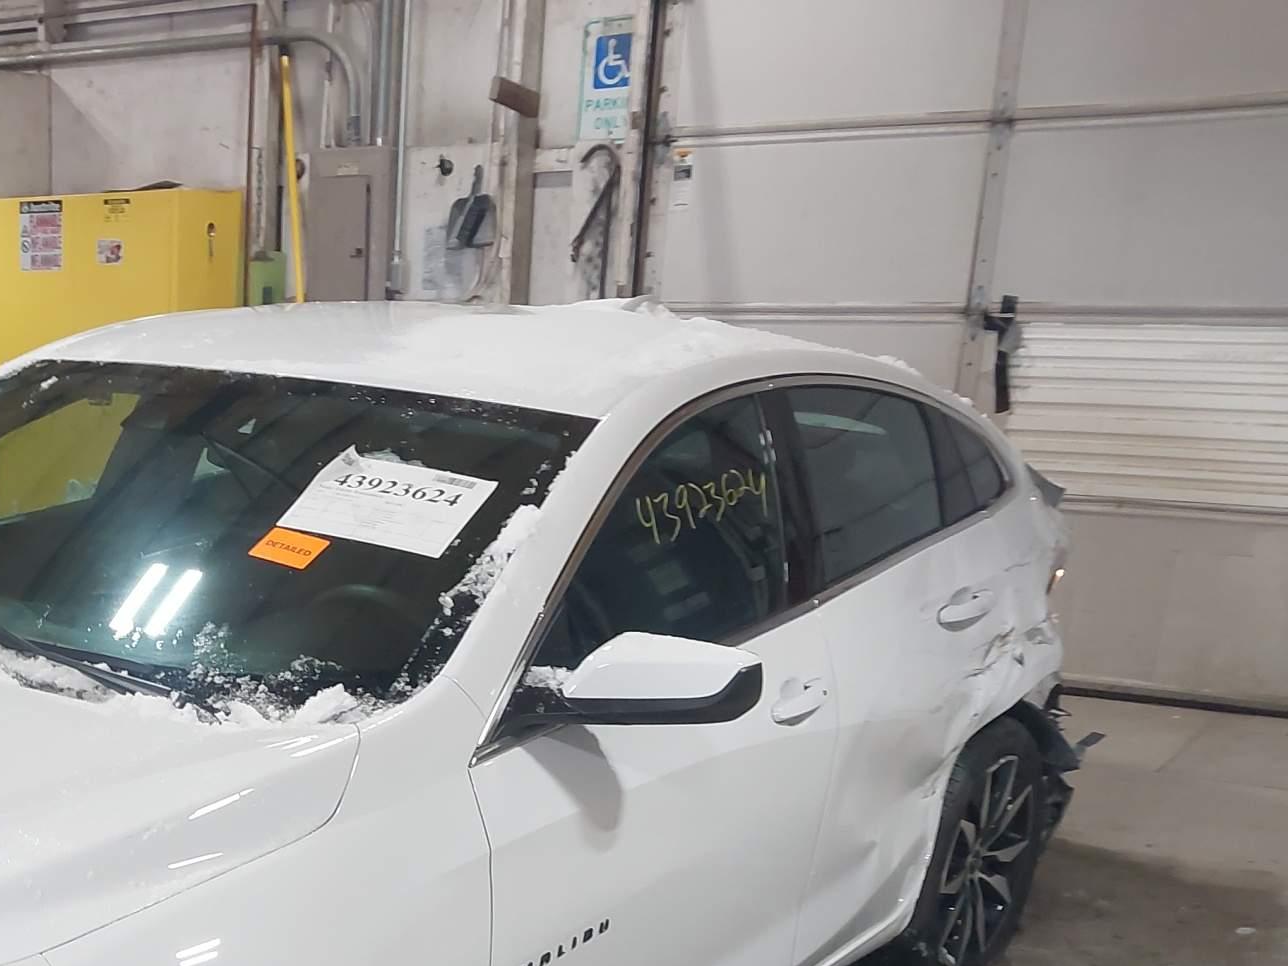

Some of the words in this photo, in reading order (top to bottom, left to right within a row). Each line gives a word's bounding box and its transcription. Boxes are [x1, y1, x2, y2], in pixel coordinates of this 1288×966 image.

[334, 473, 464, 507] 43923624
[635, 468, 769, 544] 43923624
[265, 540, 312, 557] DETAILED
